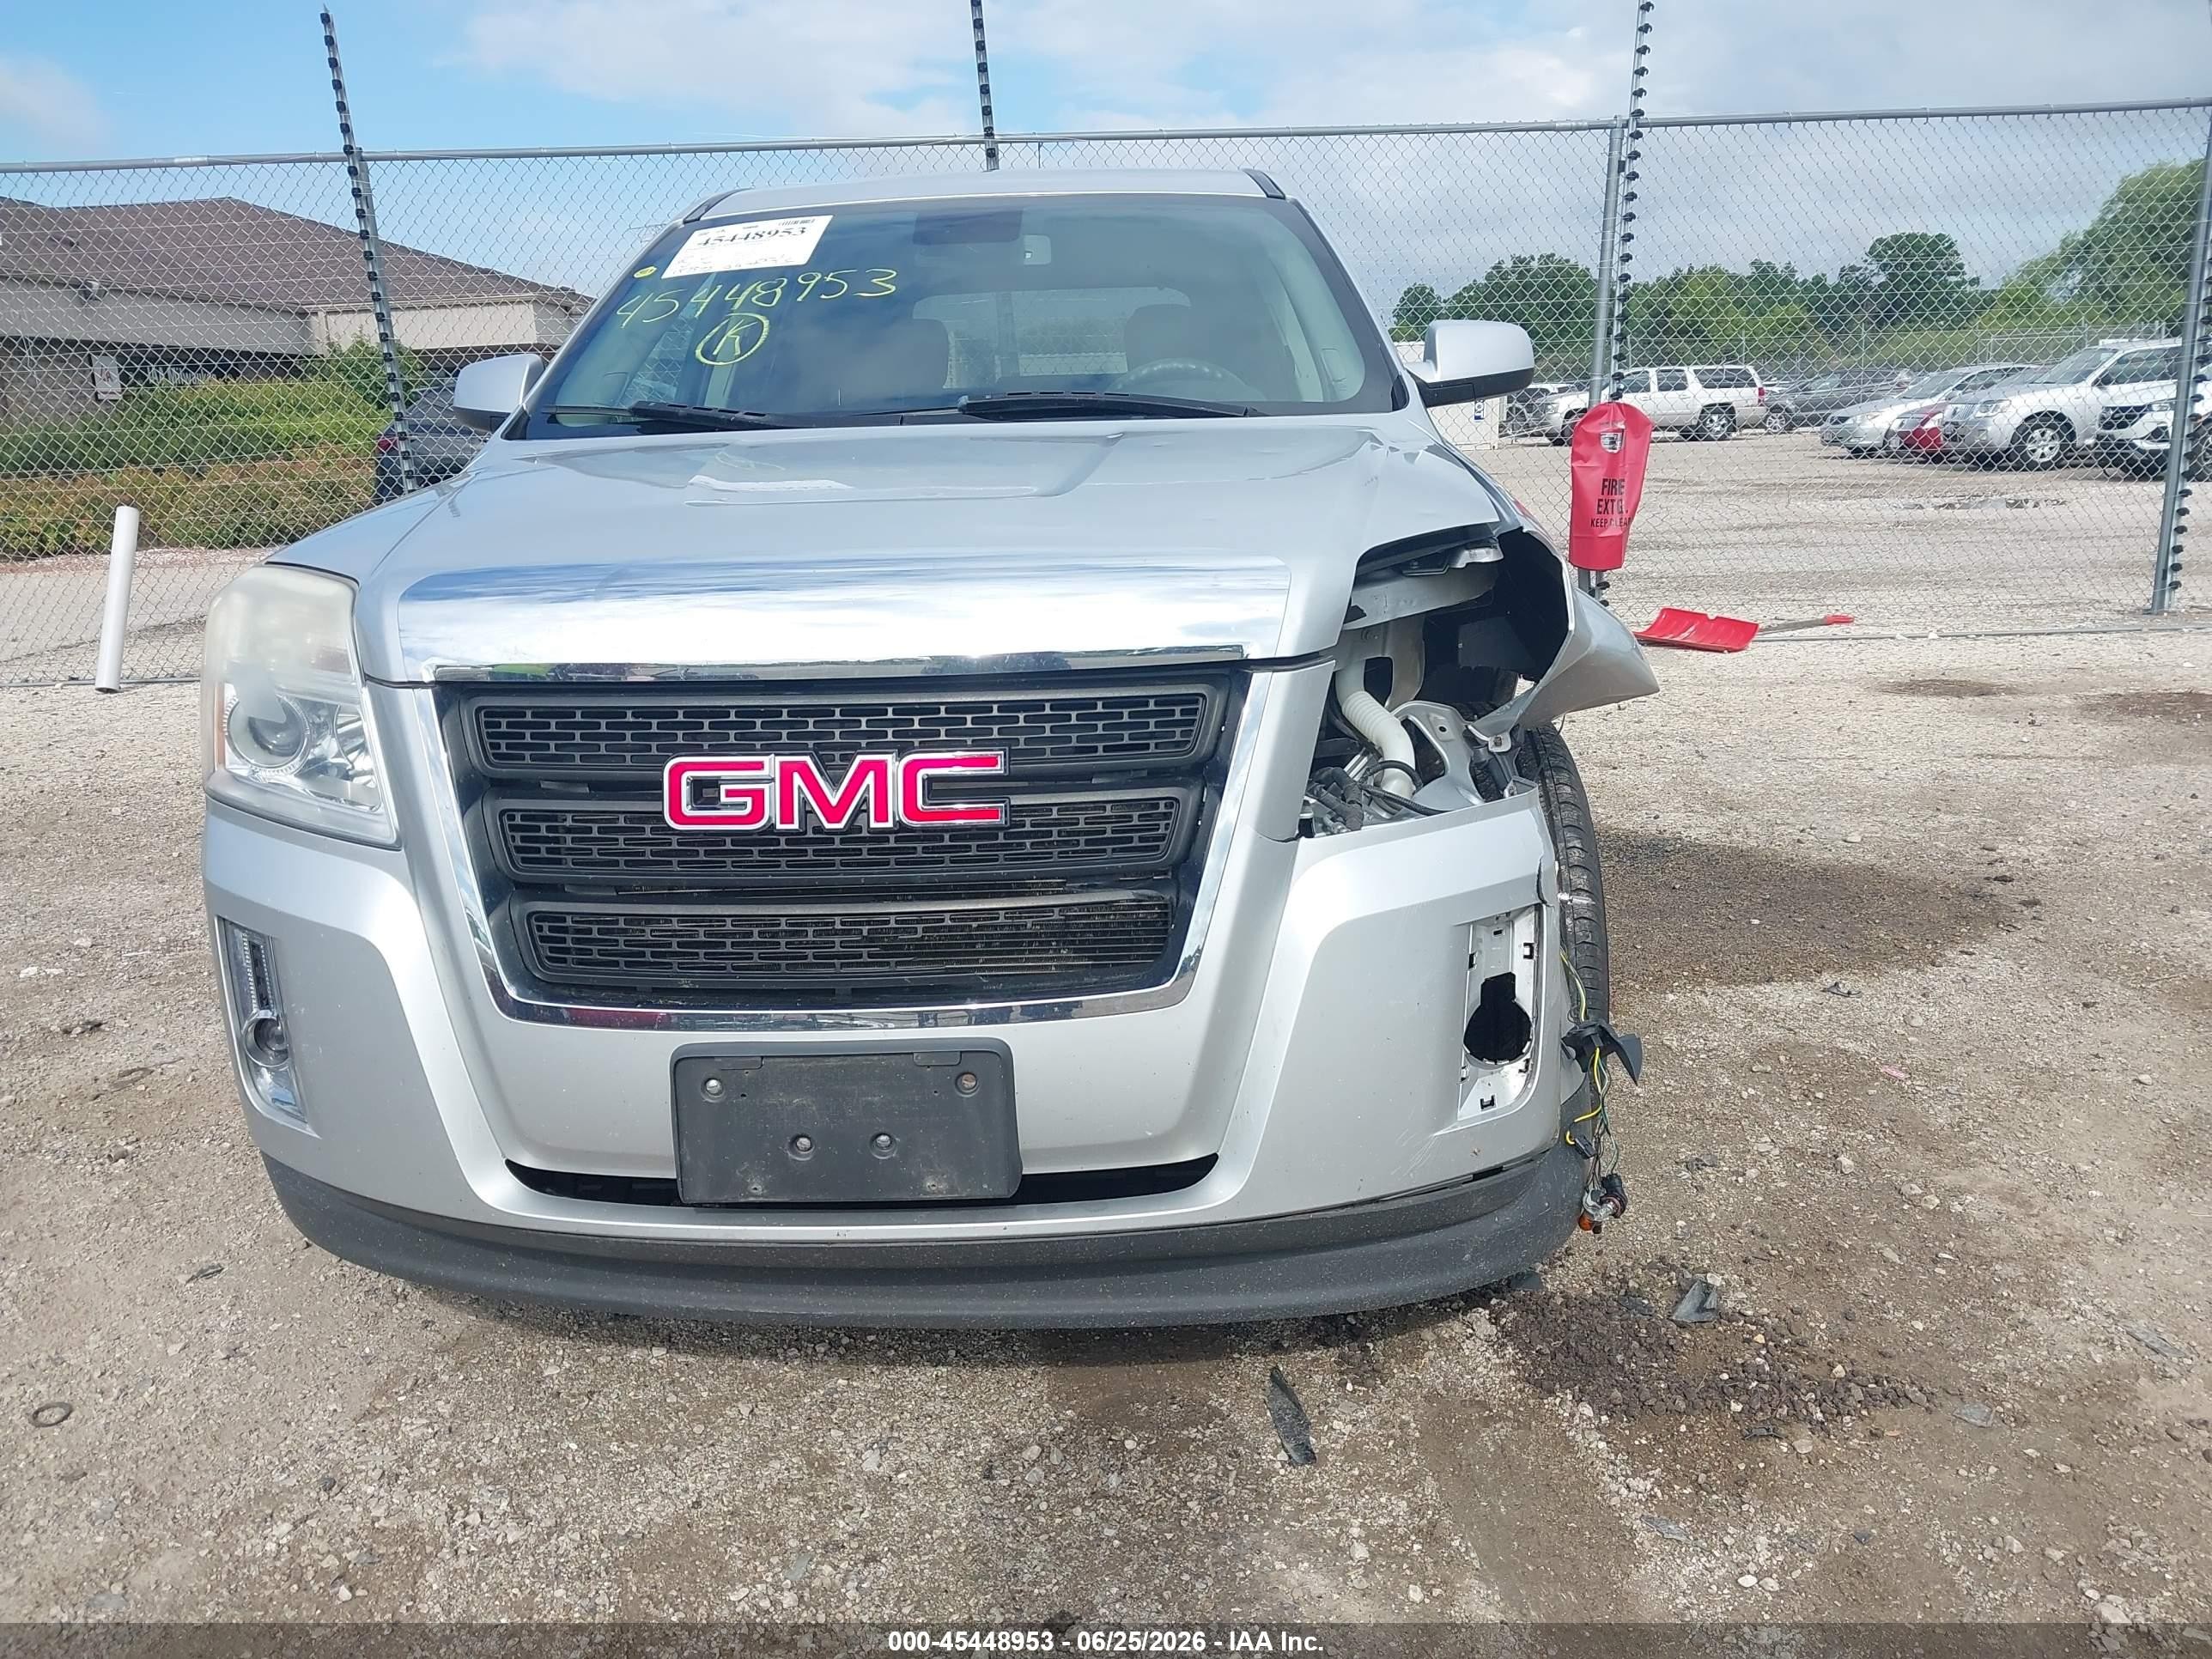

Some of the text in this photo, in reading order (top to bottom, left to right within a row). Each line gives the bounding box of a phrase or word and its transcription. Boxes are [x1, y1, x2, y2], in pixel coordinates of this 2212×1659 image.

[616, 268, 898, 329] 45448953
[1601, 477, 1625, 495] FIRE
[1590, 518, 1608, 528] KEEP
[663, 750, 1008, 831] GMC
